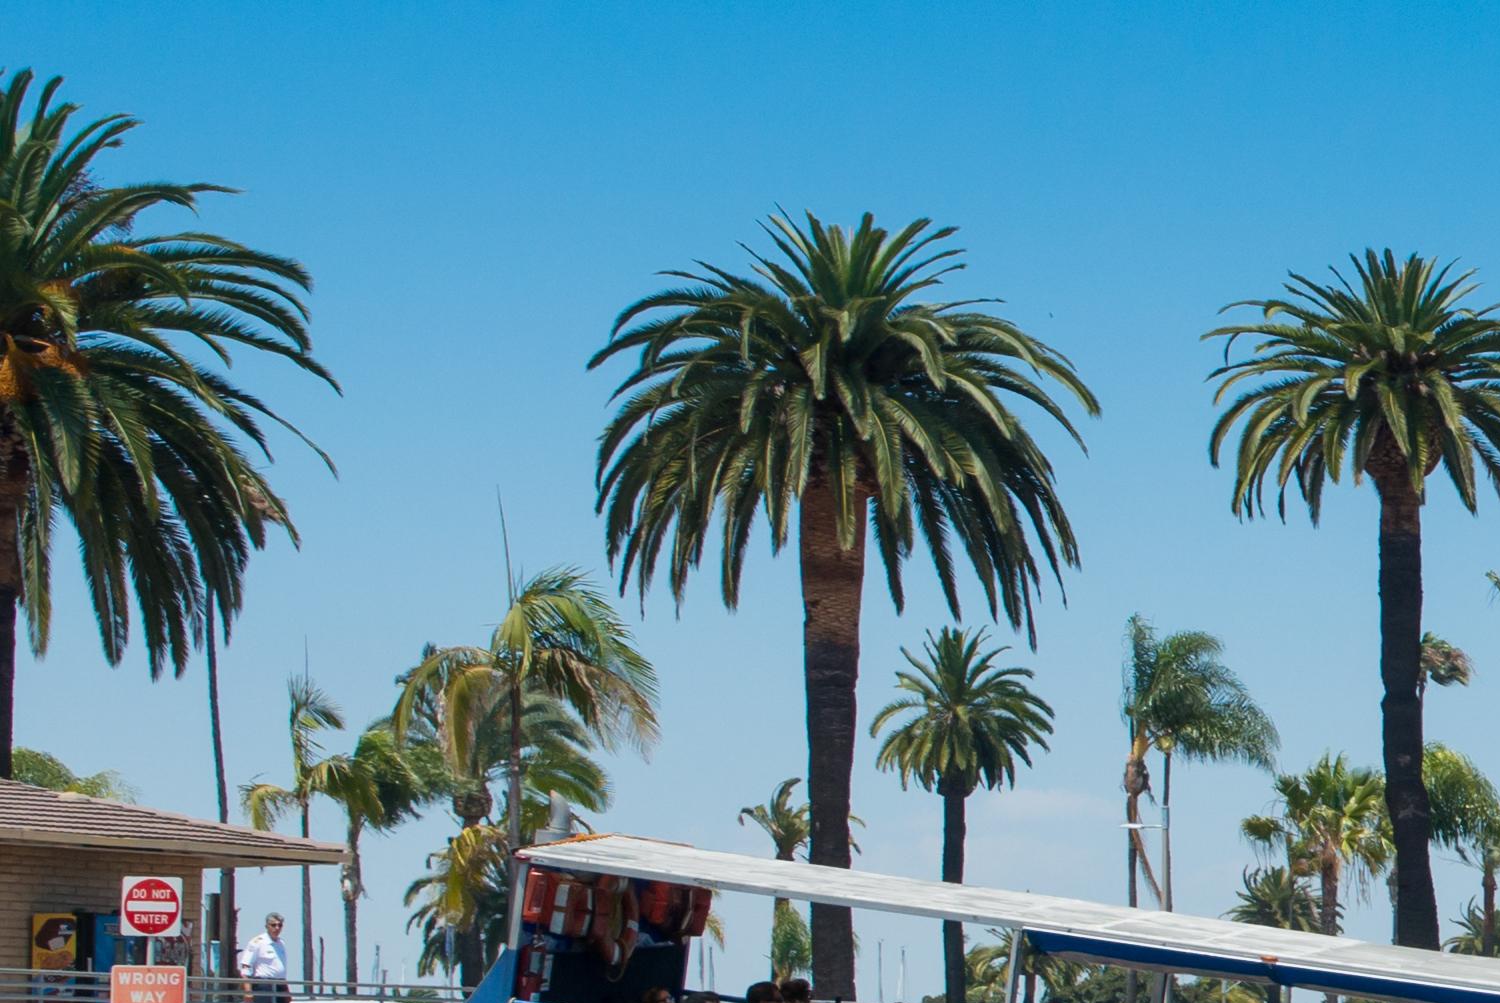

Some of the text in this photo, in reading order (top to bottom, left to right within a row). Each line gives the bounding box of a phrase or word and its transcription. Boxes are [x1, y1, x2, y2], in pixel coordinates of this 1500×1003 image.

[132, 888, 171, 899] DO NOT
[134, 914, 168, 924] ENTER
[119, 972, 180, 985] WRONG
[130, 991, 166, 1003] WAY
